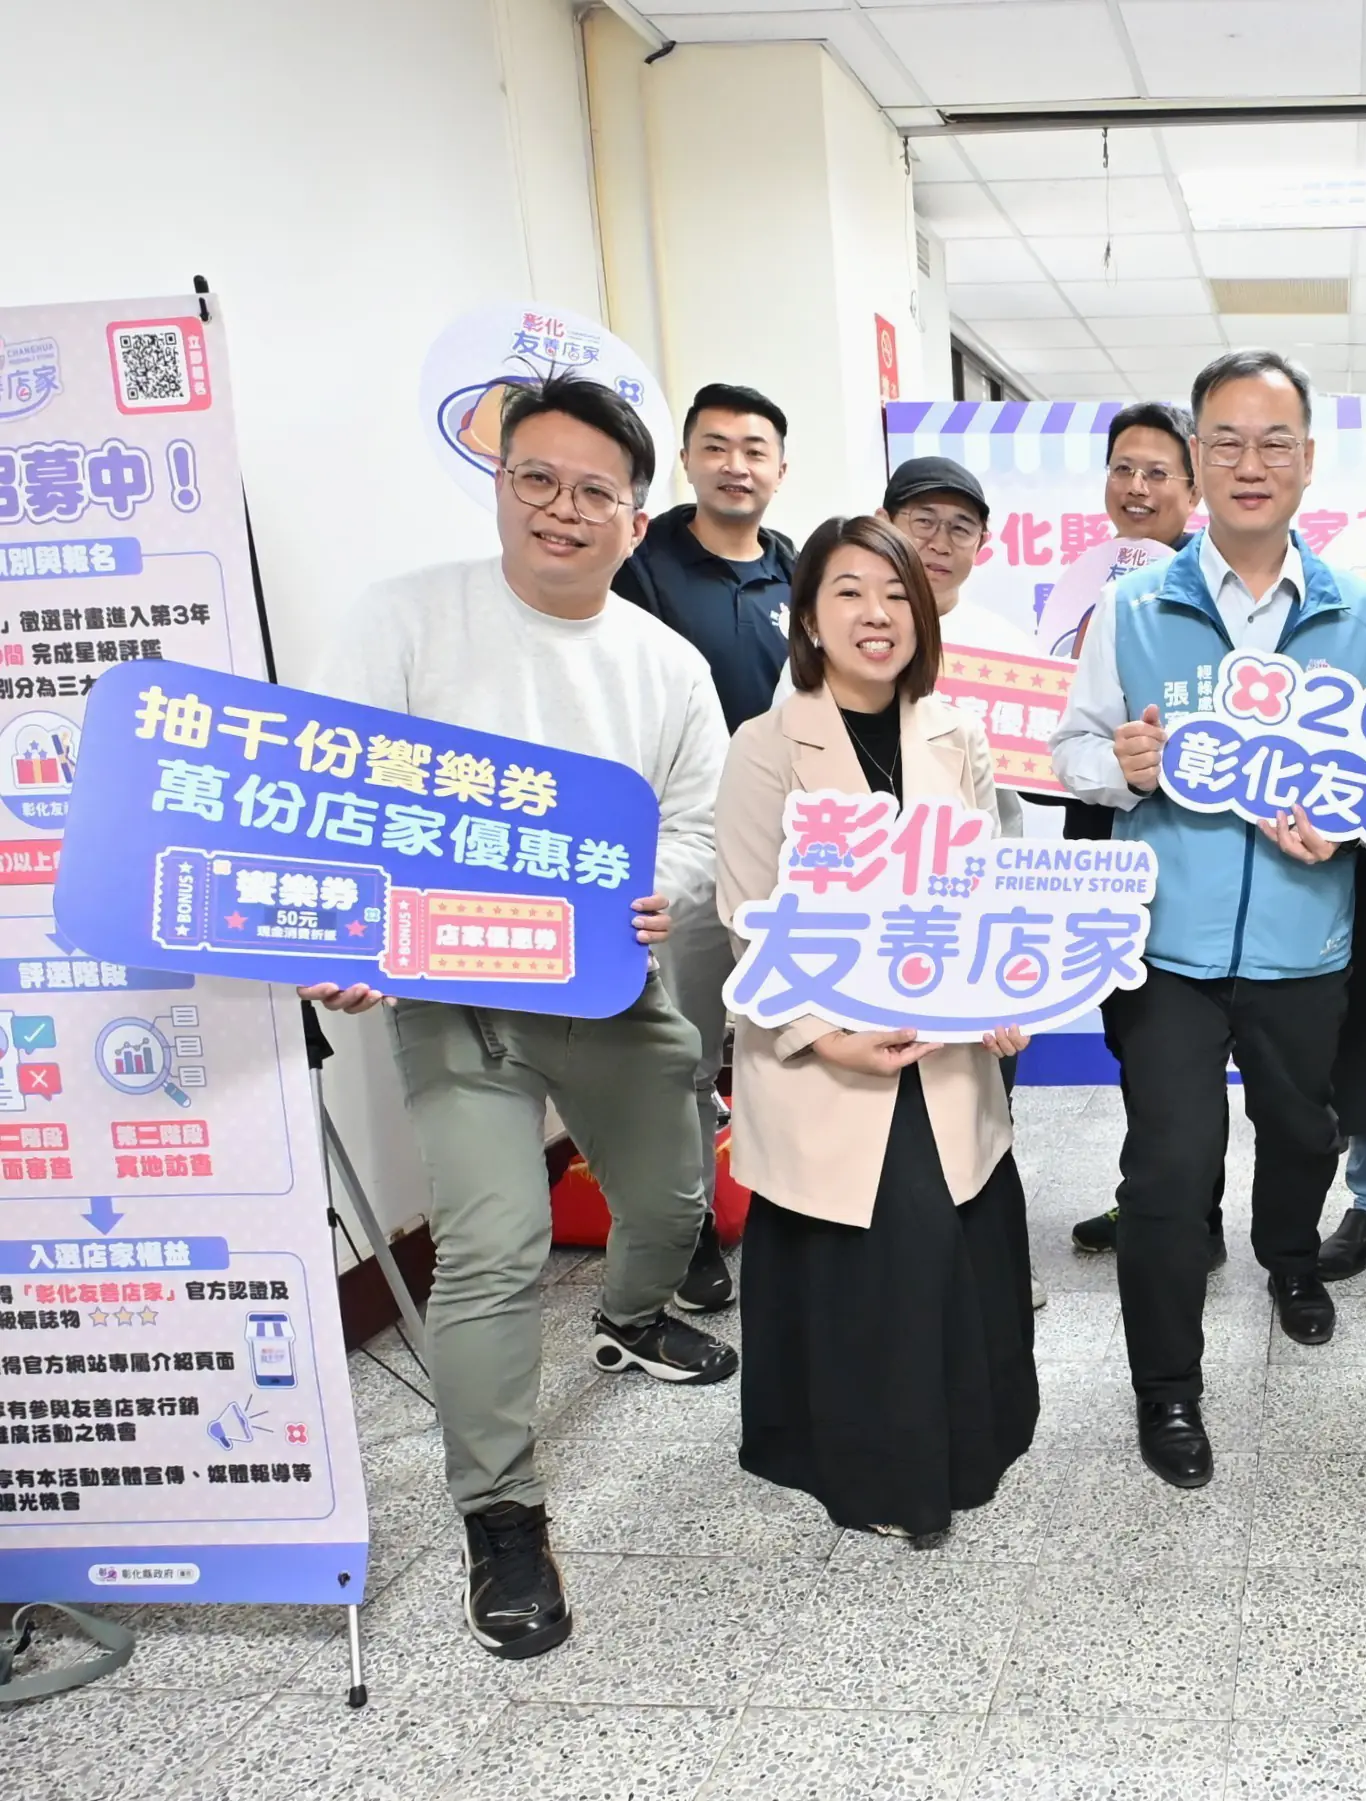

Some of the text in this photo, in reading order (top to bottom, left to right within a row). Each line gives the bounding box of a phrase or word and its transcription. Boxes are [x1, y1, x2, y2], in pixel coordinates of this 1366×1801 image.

[522, 312, 566, 338] 彰化
[1117, 548, 1147, 566] 彰化
[134, 685, 558, 818] 抽千份饗樂券
[151, 757, 632, 890] 萬份店家優惠券
[788, 797, 984, 898] 彰化
[995, 847, 1150, 874] CHANGHUA
[236, 868, 359, 911] 饗樂券
[995, 876, 1147, 894] FRIENDLY STORE
[176, 875, 194, 924] BONUS
[276, 910, 319, 928] 50元
[398, 912, 412, 955] BONUS
[435, 924, 557, 951] 店家優惠券
[733, 893, 1142, 1032] 友善店家
[115, 1124, 205, 1147] 第二階段
[115, 1154, 213, 1179] 實地訪查
[29, 1240, 191, 1270] 入選店家權益
[0, 1351, 235, 1377] 得官方網站專屬介紹頁面
[0, 1396, 200, 1420] 有參與友善店家行銷
